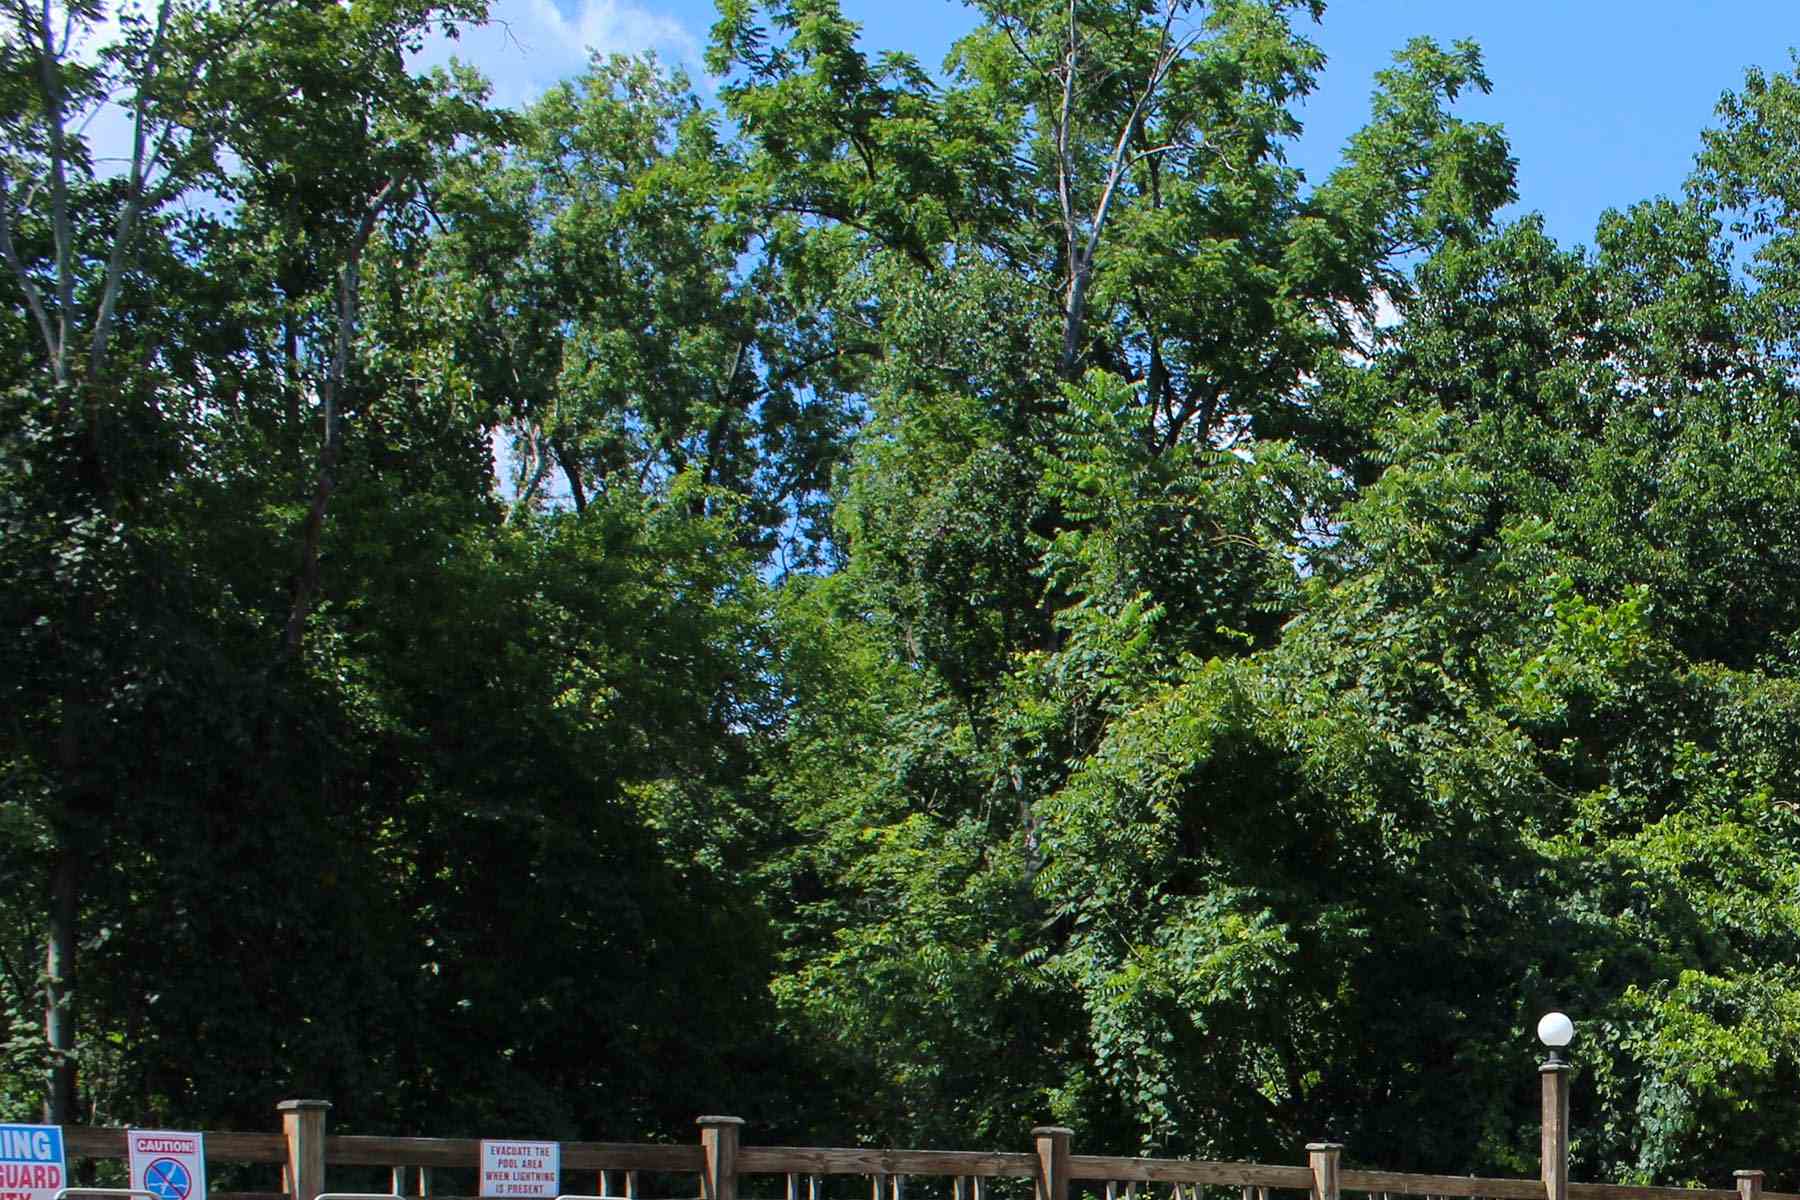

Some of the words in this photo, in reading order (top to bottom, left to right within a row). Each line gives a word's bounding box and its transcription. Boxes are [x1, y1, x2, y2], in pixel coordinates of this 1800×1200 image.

[0, 1129, 51, 1160] ING
[490, 1146, 531, 1156] EVACUATE
[535, 1147, 550, 1157] THE
[498, 1159, 518, 1168] POOL
[522, 1160, 543, 1169] AREA
[486, 1172, 510, 1181] WHEN
[512, 1172, 555, 1182] LIGHTNING
[496, 1185, 504, 1193] IS
[507, 1185, 544, 1194] PRESENT
